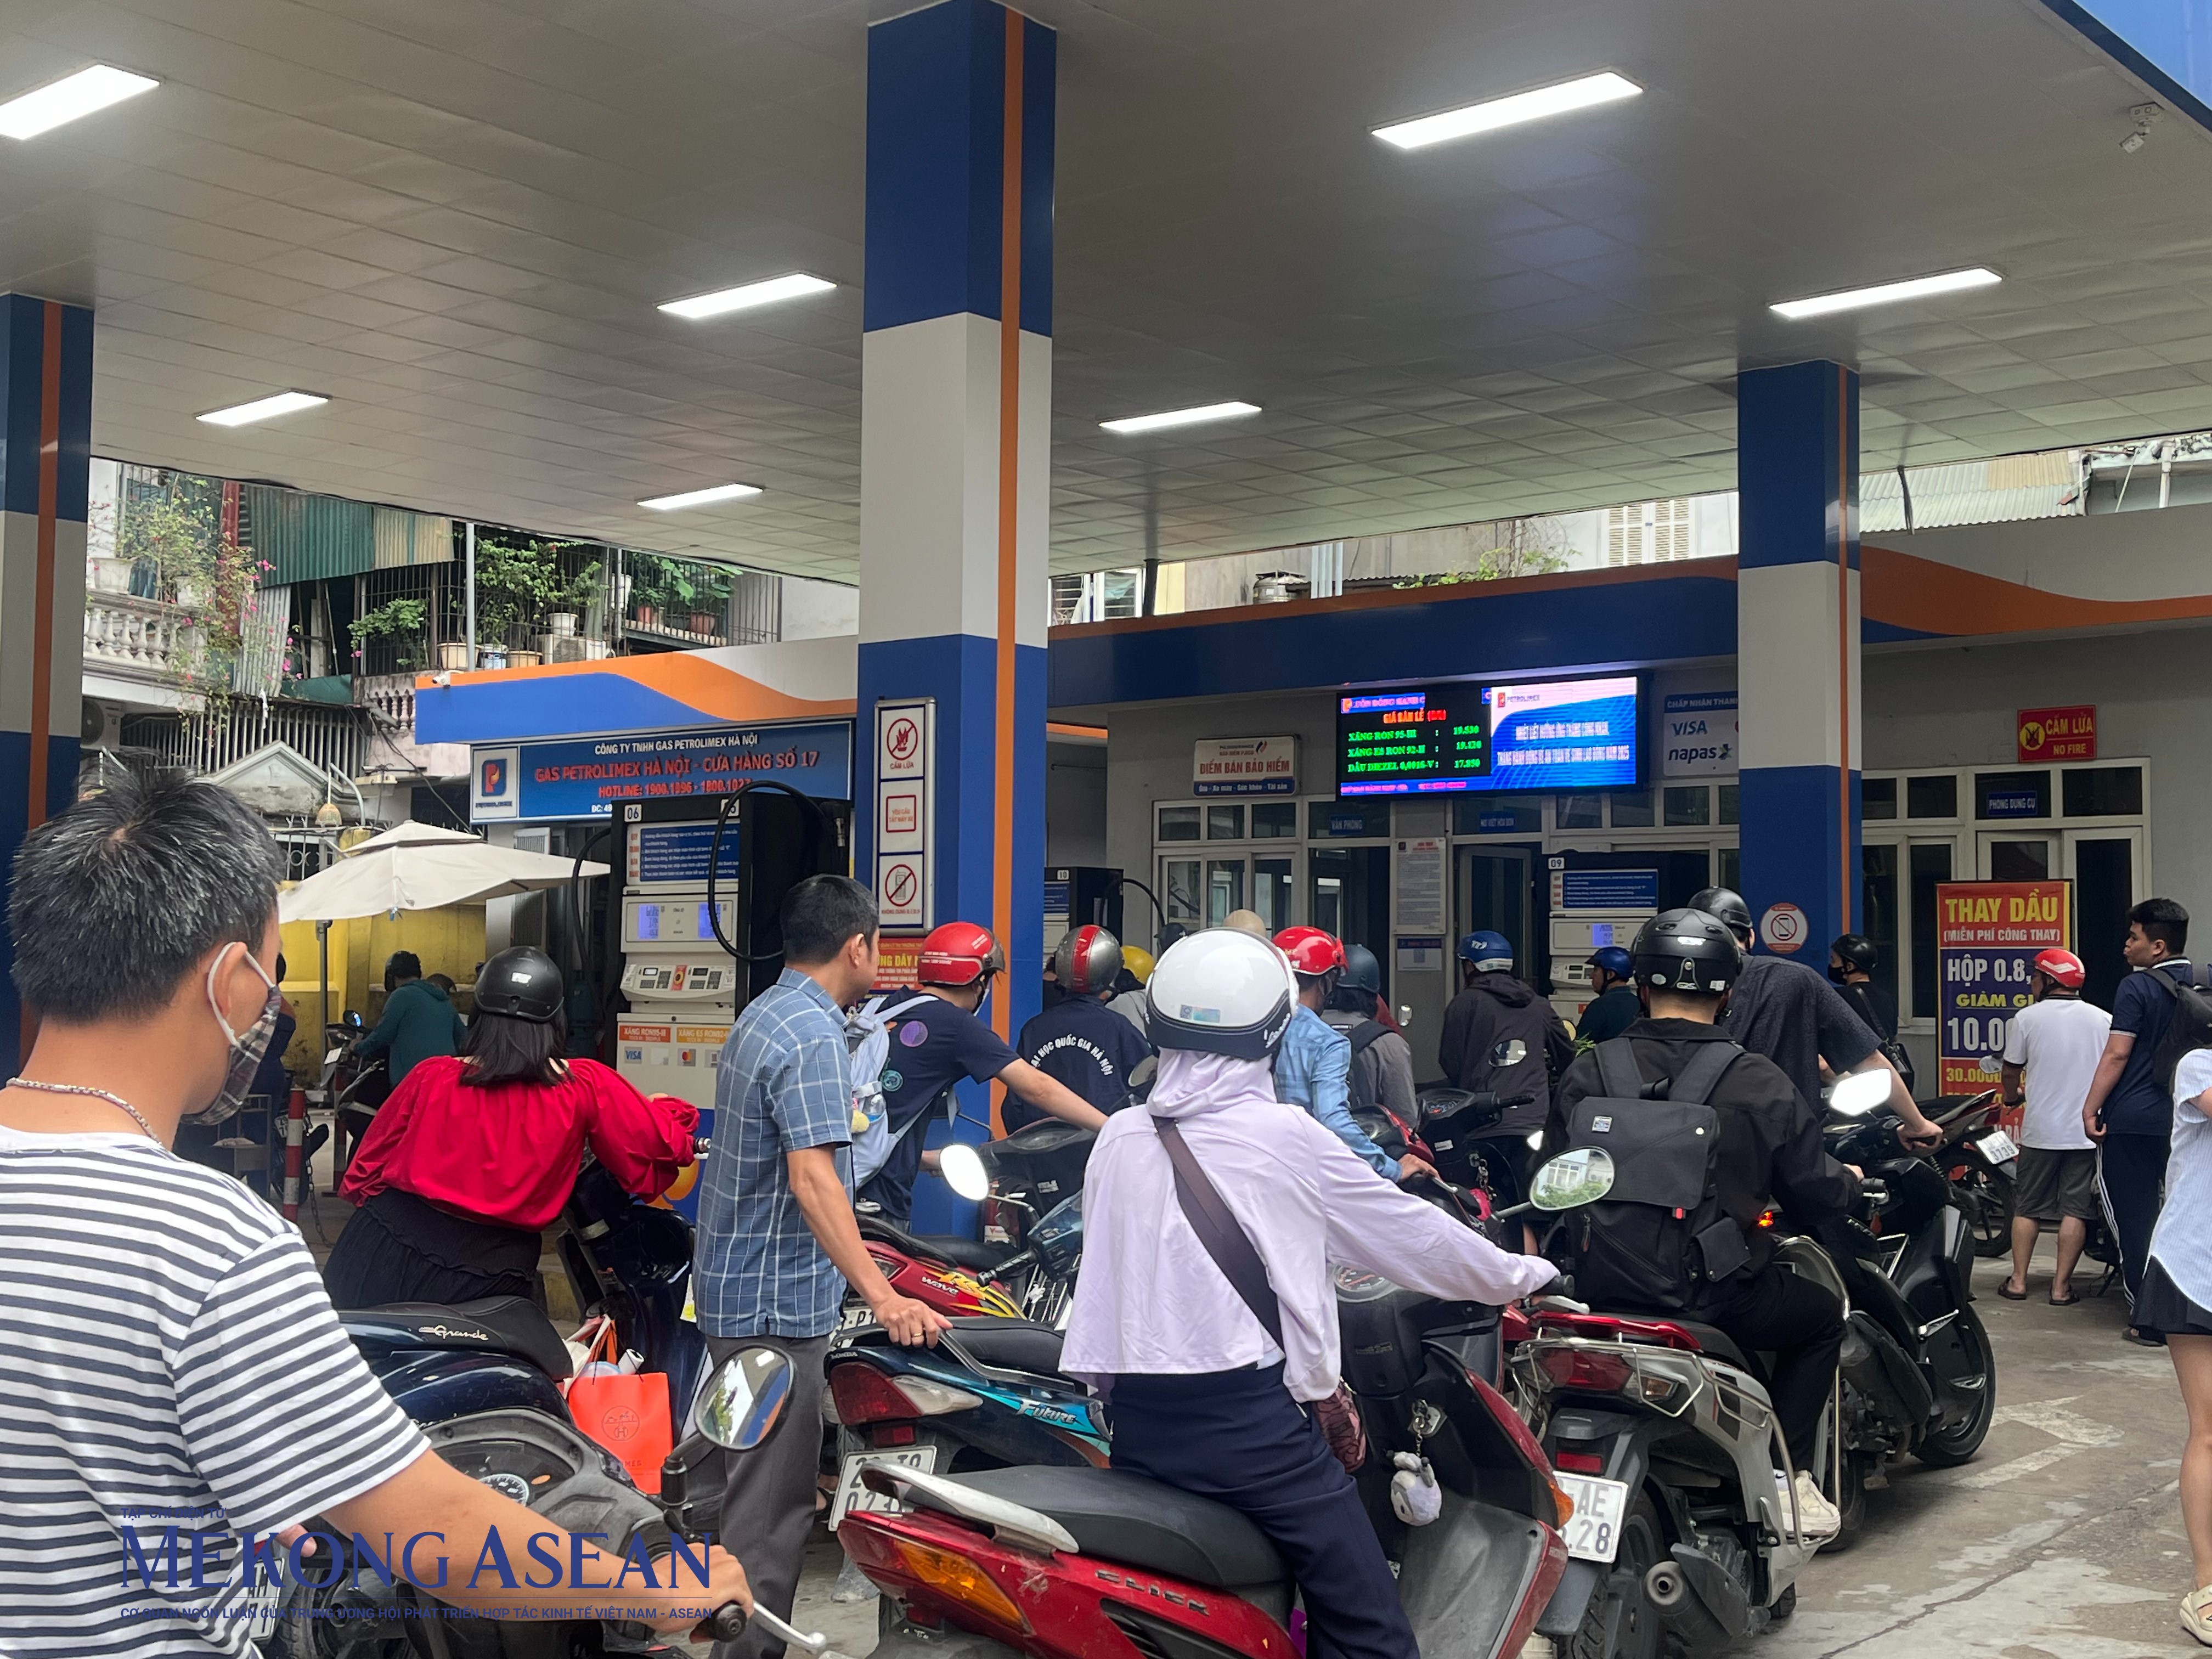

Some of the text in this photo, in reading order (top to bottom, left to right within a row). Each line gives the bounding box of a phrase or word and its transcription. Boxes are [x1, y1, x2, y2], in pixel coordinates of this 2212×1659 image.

[1667, 698, 1688, 708] CHẤP
[1690, 698, 1712, 708] NHẬN
[1671, 720, 1708, 736] VISA
[2046, 712, 2092, 735] CẤM LỬA
[595, 731, 758, 755] CÔNG TY TNHH GAS PETROLIMEX HÀ NỘI
[1374, 730, 1394, 740] RON
[1386, 746, 1406, 755] RON
[1668, 747, 1717, 764] napas
[2053, 743, 2086, 755] NO FIRE
[535, 766, 560, 783] GAS
[562, 760, 641, 781] PETROLIMEX
[644, 755, 663, 776] HÀ
[665, 754, 691, 778] NỘI
[703, 752, 730, 772] CỬA
[733, 750, 772, 771] HÀNG
[776, 745, 797, 769] SỐ
[801, 751, 819, 768] 17
[1224, 759, 1243, 774] BÁN
[1245, 757, 1263, 772] BẢO
[1266, 755, 1290, 772] HIỂM
[599, 784, 642, 799] HOTLINE:
[627, 806, 639, 820] 06
[1550, 859, 1562, 867] 09
[1945, 888, 2058, 923] THAY DẦU
[1944, 926, 2060, 943] (MIỄN PHÍ CÔNG THAY)
[895, 953, 912, 967] DÂY
[1948, 953, 2032, 986] HỘP 0.8,
[1956, 990, 2006, 1007] GIẢM
[624, 1050, 641, 1060] VISA
[1031, 1033, 1114, 1076] ẠI HỌC QUỐC GIA HÀ NỘI
[922, 1277, 959, 1295] wave
[419, 1325, 489, 1340] Grande
